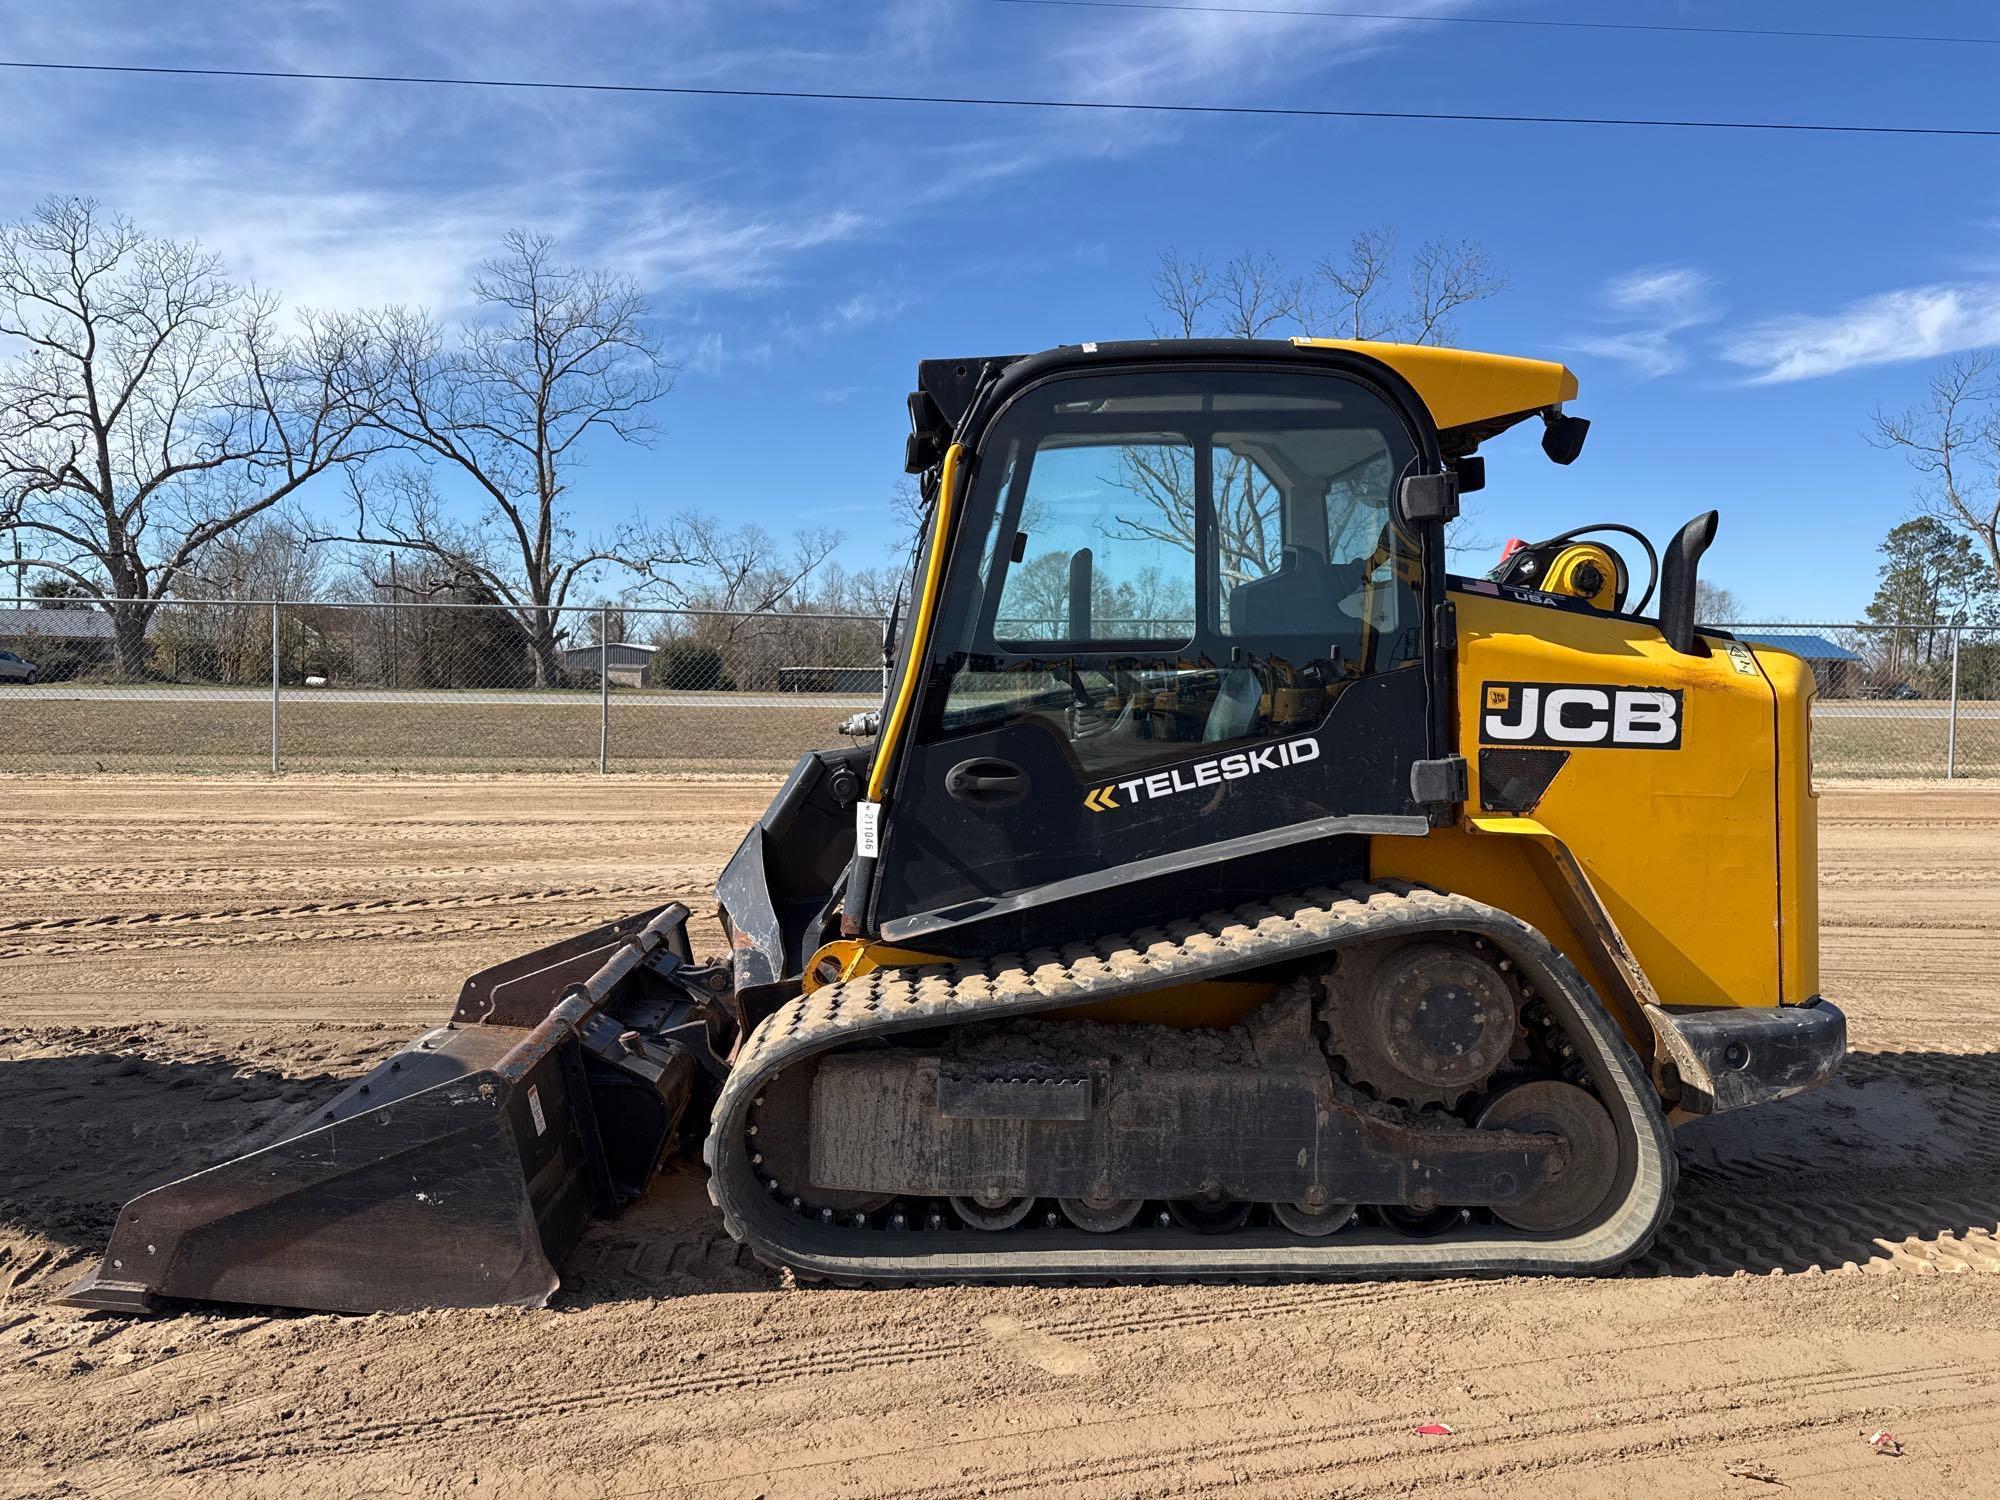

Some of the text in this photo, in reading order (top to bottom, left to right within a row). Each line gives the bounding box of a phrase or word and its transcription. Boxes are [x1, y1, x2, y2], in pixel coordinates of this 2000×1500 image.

[1514, 592, 1558, 607] USA
[1485, 688, 1677, 744] JCB
[1118, 737, 1320, 803] TELESKID
[864, 813, 874, 850] 211046
